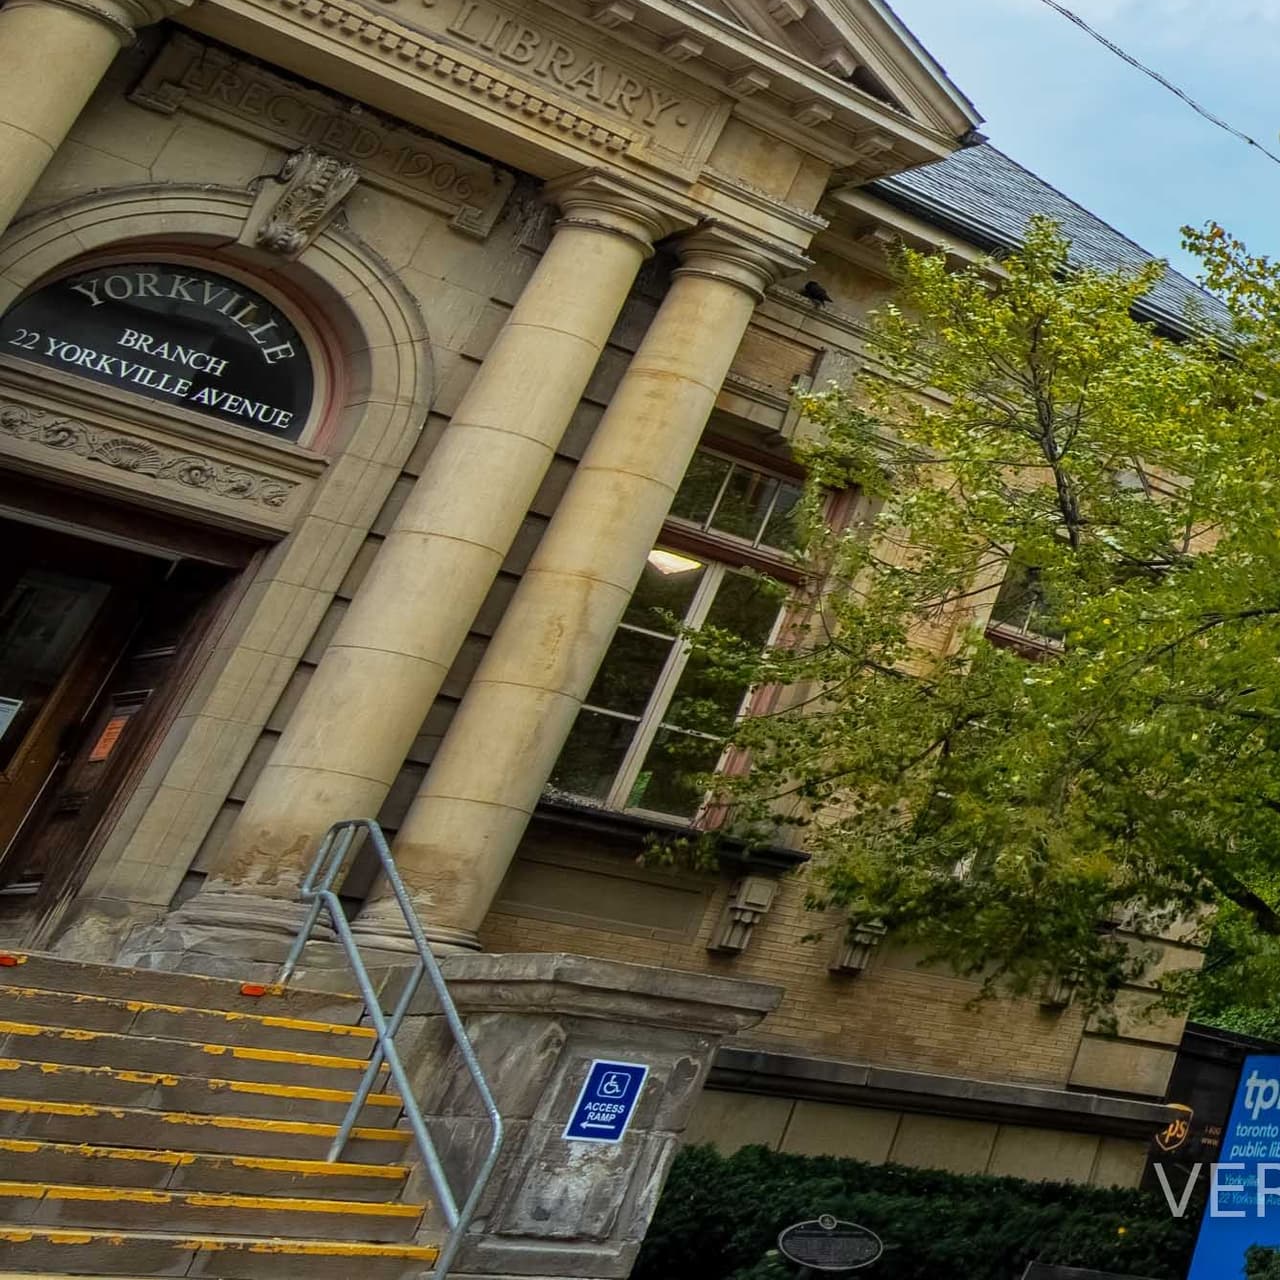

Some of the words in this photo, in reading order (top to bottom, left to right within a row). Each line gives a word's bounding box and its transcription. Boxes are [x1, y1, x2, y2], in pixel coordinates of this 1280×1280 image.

[181, 54, 383, 160] ERECTED
[397, 146, 475, 199] 1906
[72, 271, 296, 365] YORKVILLE
[117, 328, 230, 377] BRANCH
[8, 328, 41, 350] 22
[44, 337, 193, 397] YORKVILLE
[190, 386, 294, 430] AVENUE
[584, 1102, 626, 1114] ACCESS
[586, 1112, 616, 1122] RAMP
[1235, 1122, 1279, 1138] toronto
[1230, 1140, 1268, 1160] public
